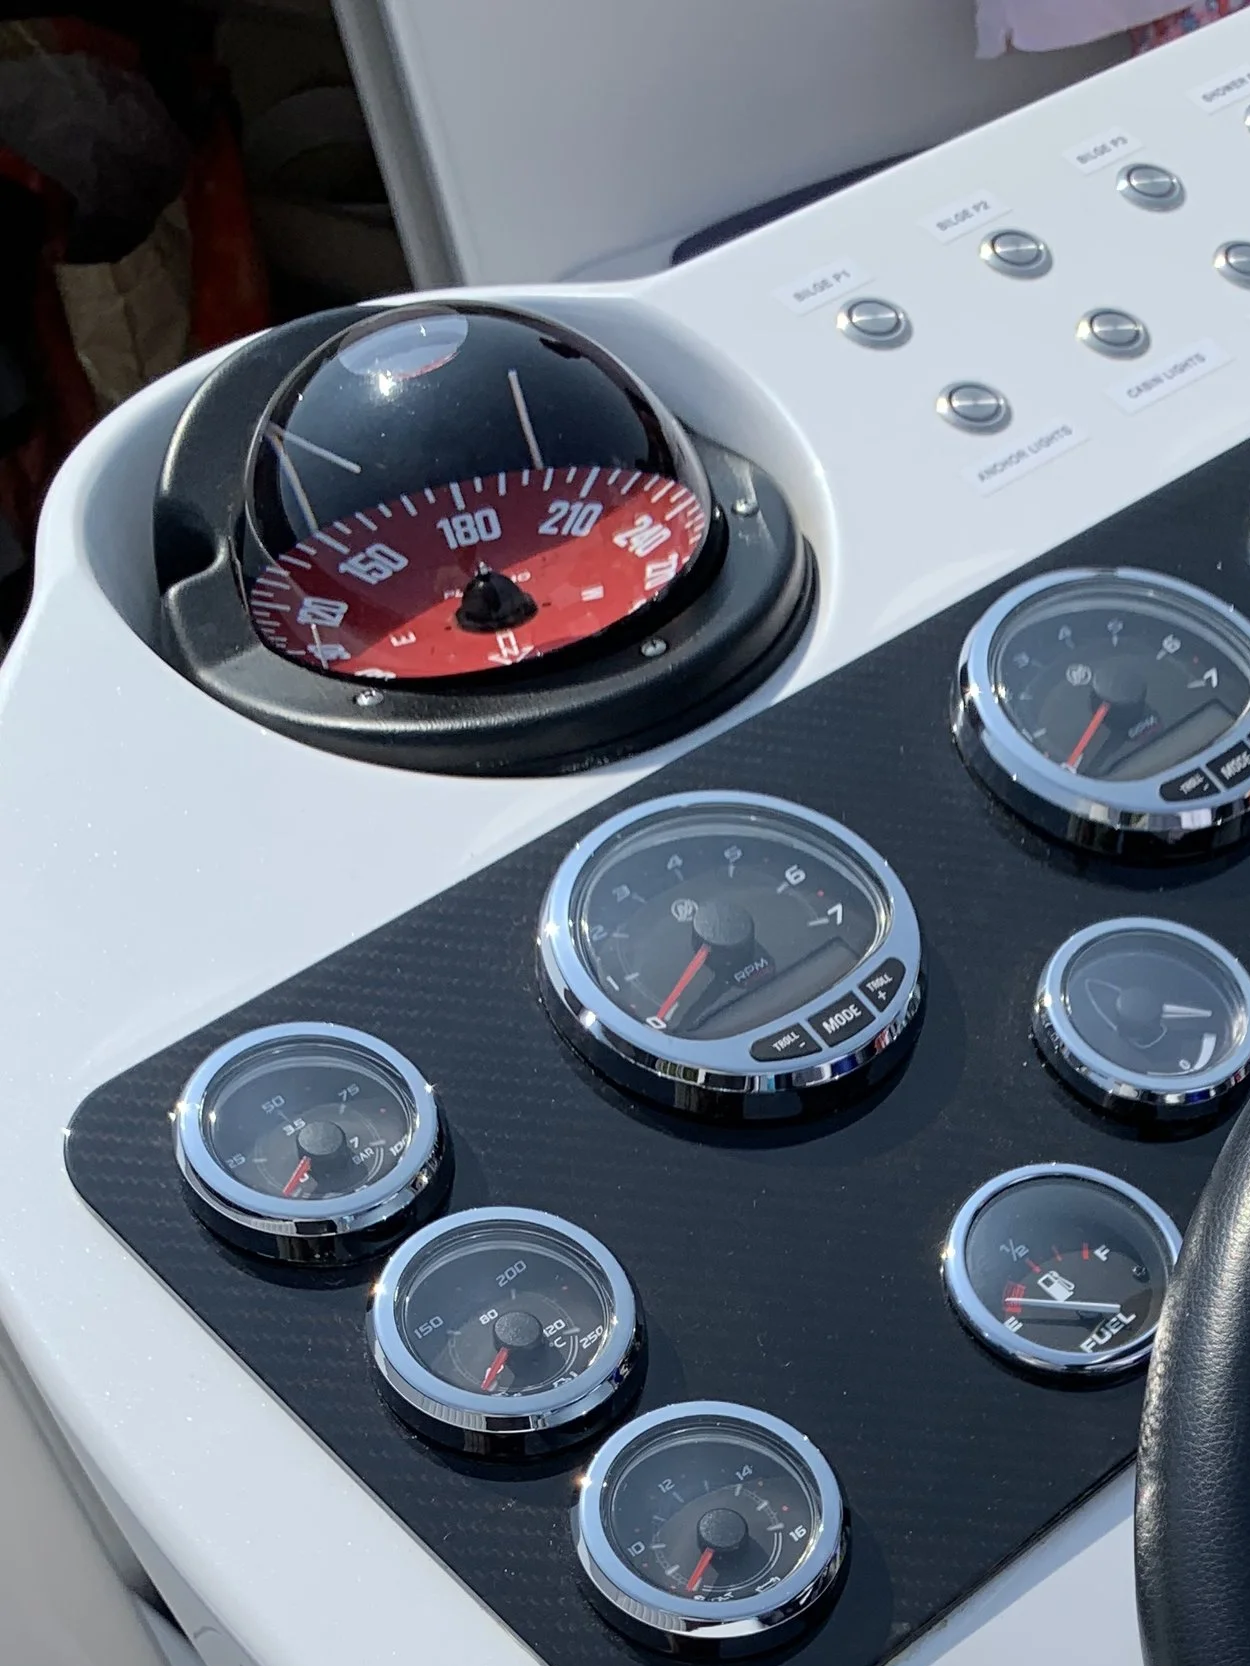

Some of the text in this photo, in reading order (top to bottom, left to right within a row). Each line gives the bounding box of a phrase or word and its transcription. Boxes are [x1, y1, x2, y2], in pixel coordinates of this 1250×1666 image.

[1202, 75, 1246, 103] SHOWER
[1076, 143, 1111, 165] BILGE
[936, 199, 991, 232] BILGE P2
[793, 269, 850, 302] BILGE P1
[1126, 352, 1206, 399] CABIN LIGHTS
[977, 424, 1073, 482] ANCHOR LIGHTS
[437, 508, 501, 549] 180
[538, 501, 604, 537] 210
[613, 514, 671, 557] 240
[338, 543, 409, 585] 150
[666, 855, 683, 871] 4
[724, 845, 742, 864] 5
[784, 865, 806, 885] 6
[827, 903, 844, 926] 7
[733, 956, 769, 984] RPM
[866, 972, 893, 993] TROLL
[822, 1003, 862, 1034] MODE
[772, 1030, 801, 1052] TROLL
[338, 1083, 361, 1102] 75
[261, 1095, 285, 1115] 50
[283, 1118, 306, 1137] 3.5
[349, 1136, 360, 1149] 7
[226, 1153, 246, 1169] 25
[352, 1147, 375, 1165] BAR
[1000, 1238, 1030, 1262] 1/2
[1093, 1243, 1111, 1262] F
[495, 1259, 527, 1288] 200
[414, 1315, 444, 1339] 150
[479, 1308, 499, 1325] 80
[1003, 1315, 1024, 1333] E
[542, 1318, 566, 1338] 120
[579, 1325, 605, 1350] 250
[1080, 1312, 1137, 1354] FUEL
[735, 1464, 753, 1481] 14
[657, 1478, 676, 1493] 12
[789, 1525, 807, 1542] 16
[627, 1540, 645, 1557] 10
